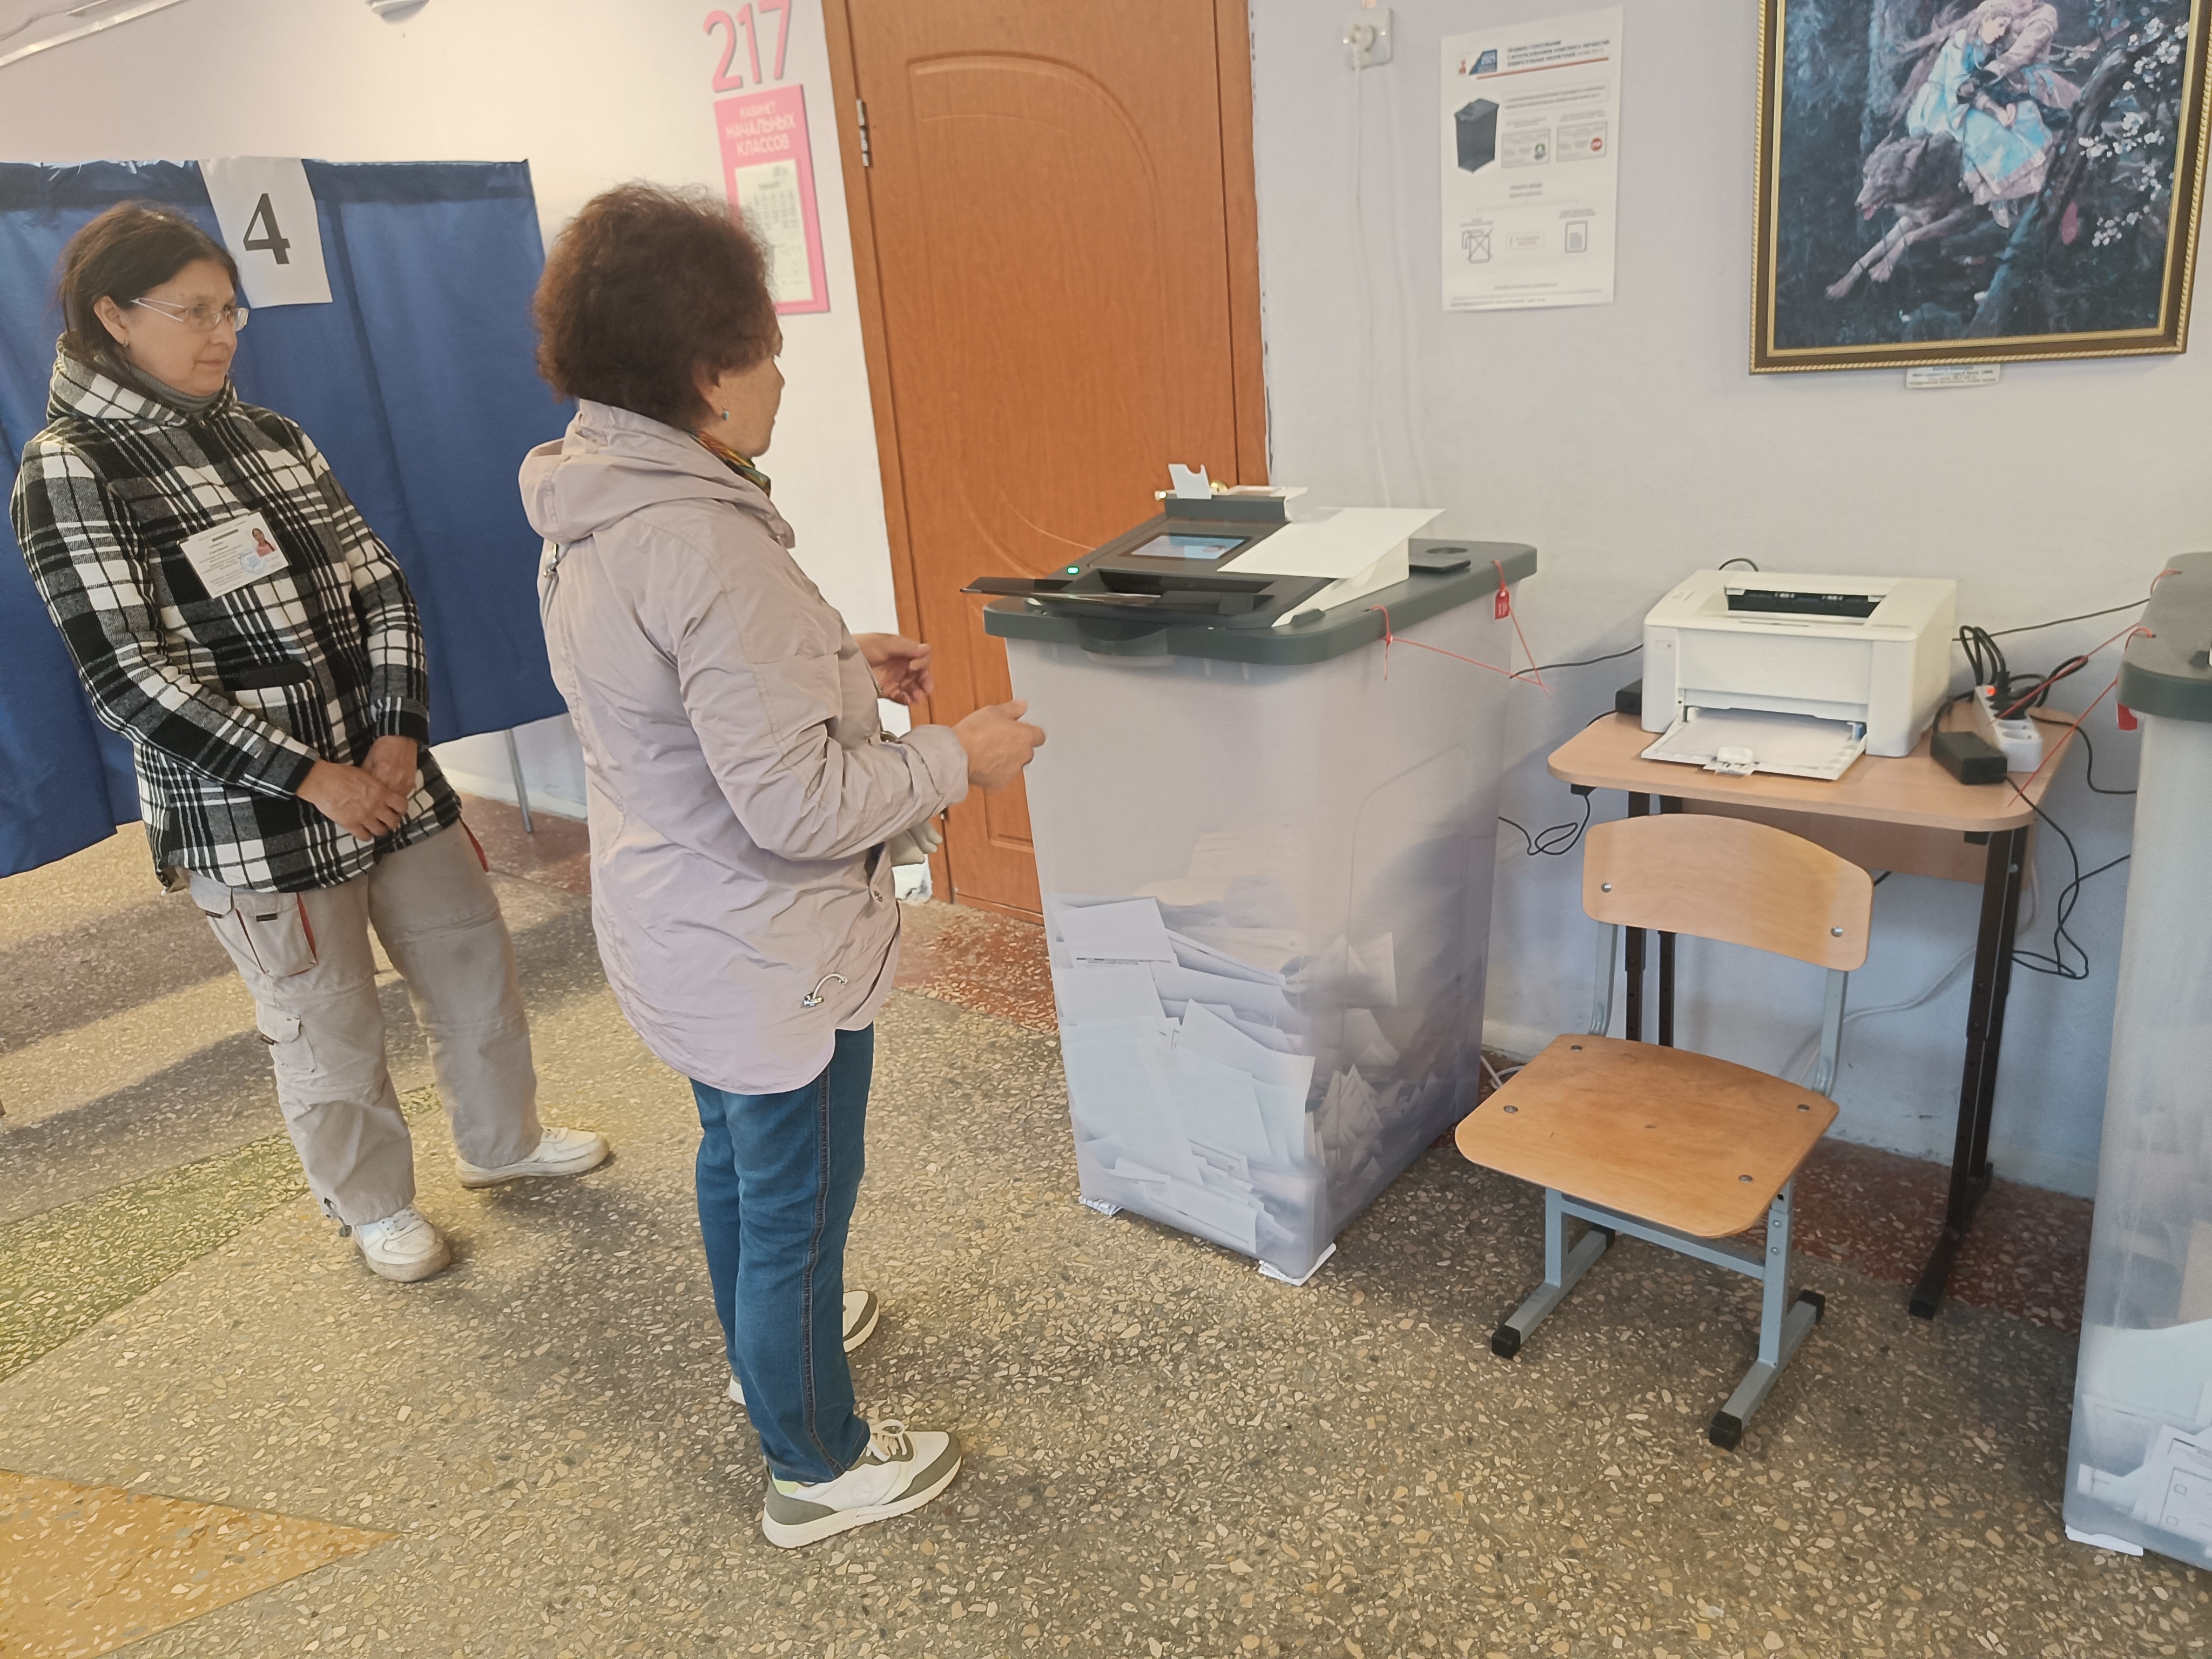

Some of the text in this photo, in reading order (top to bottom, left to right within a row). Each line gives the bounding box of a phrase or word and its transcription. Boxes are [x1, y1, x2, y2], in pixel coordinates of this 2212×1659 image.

[704, 0, 793, 92] 217
[725, 113, 796, 140] НАЧАЛЬНЫХ
[736, 133, 790, 157] КЛАССОВ
[243, 193, 291, 264] 4
